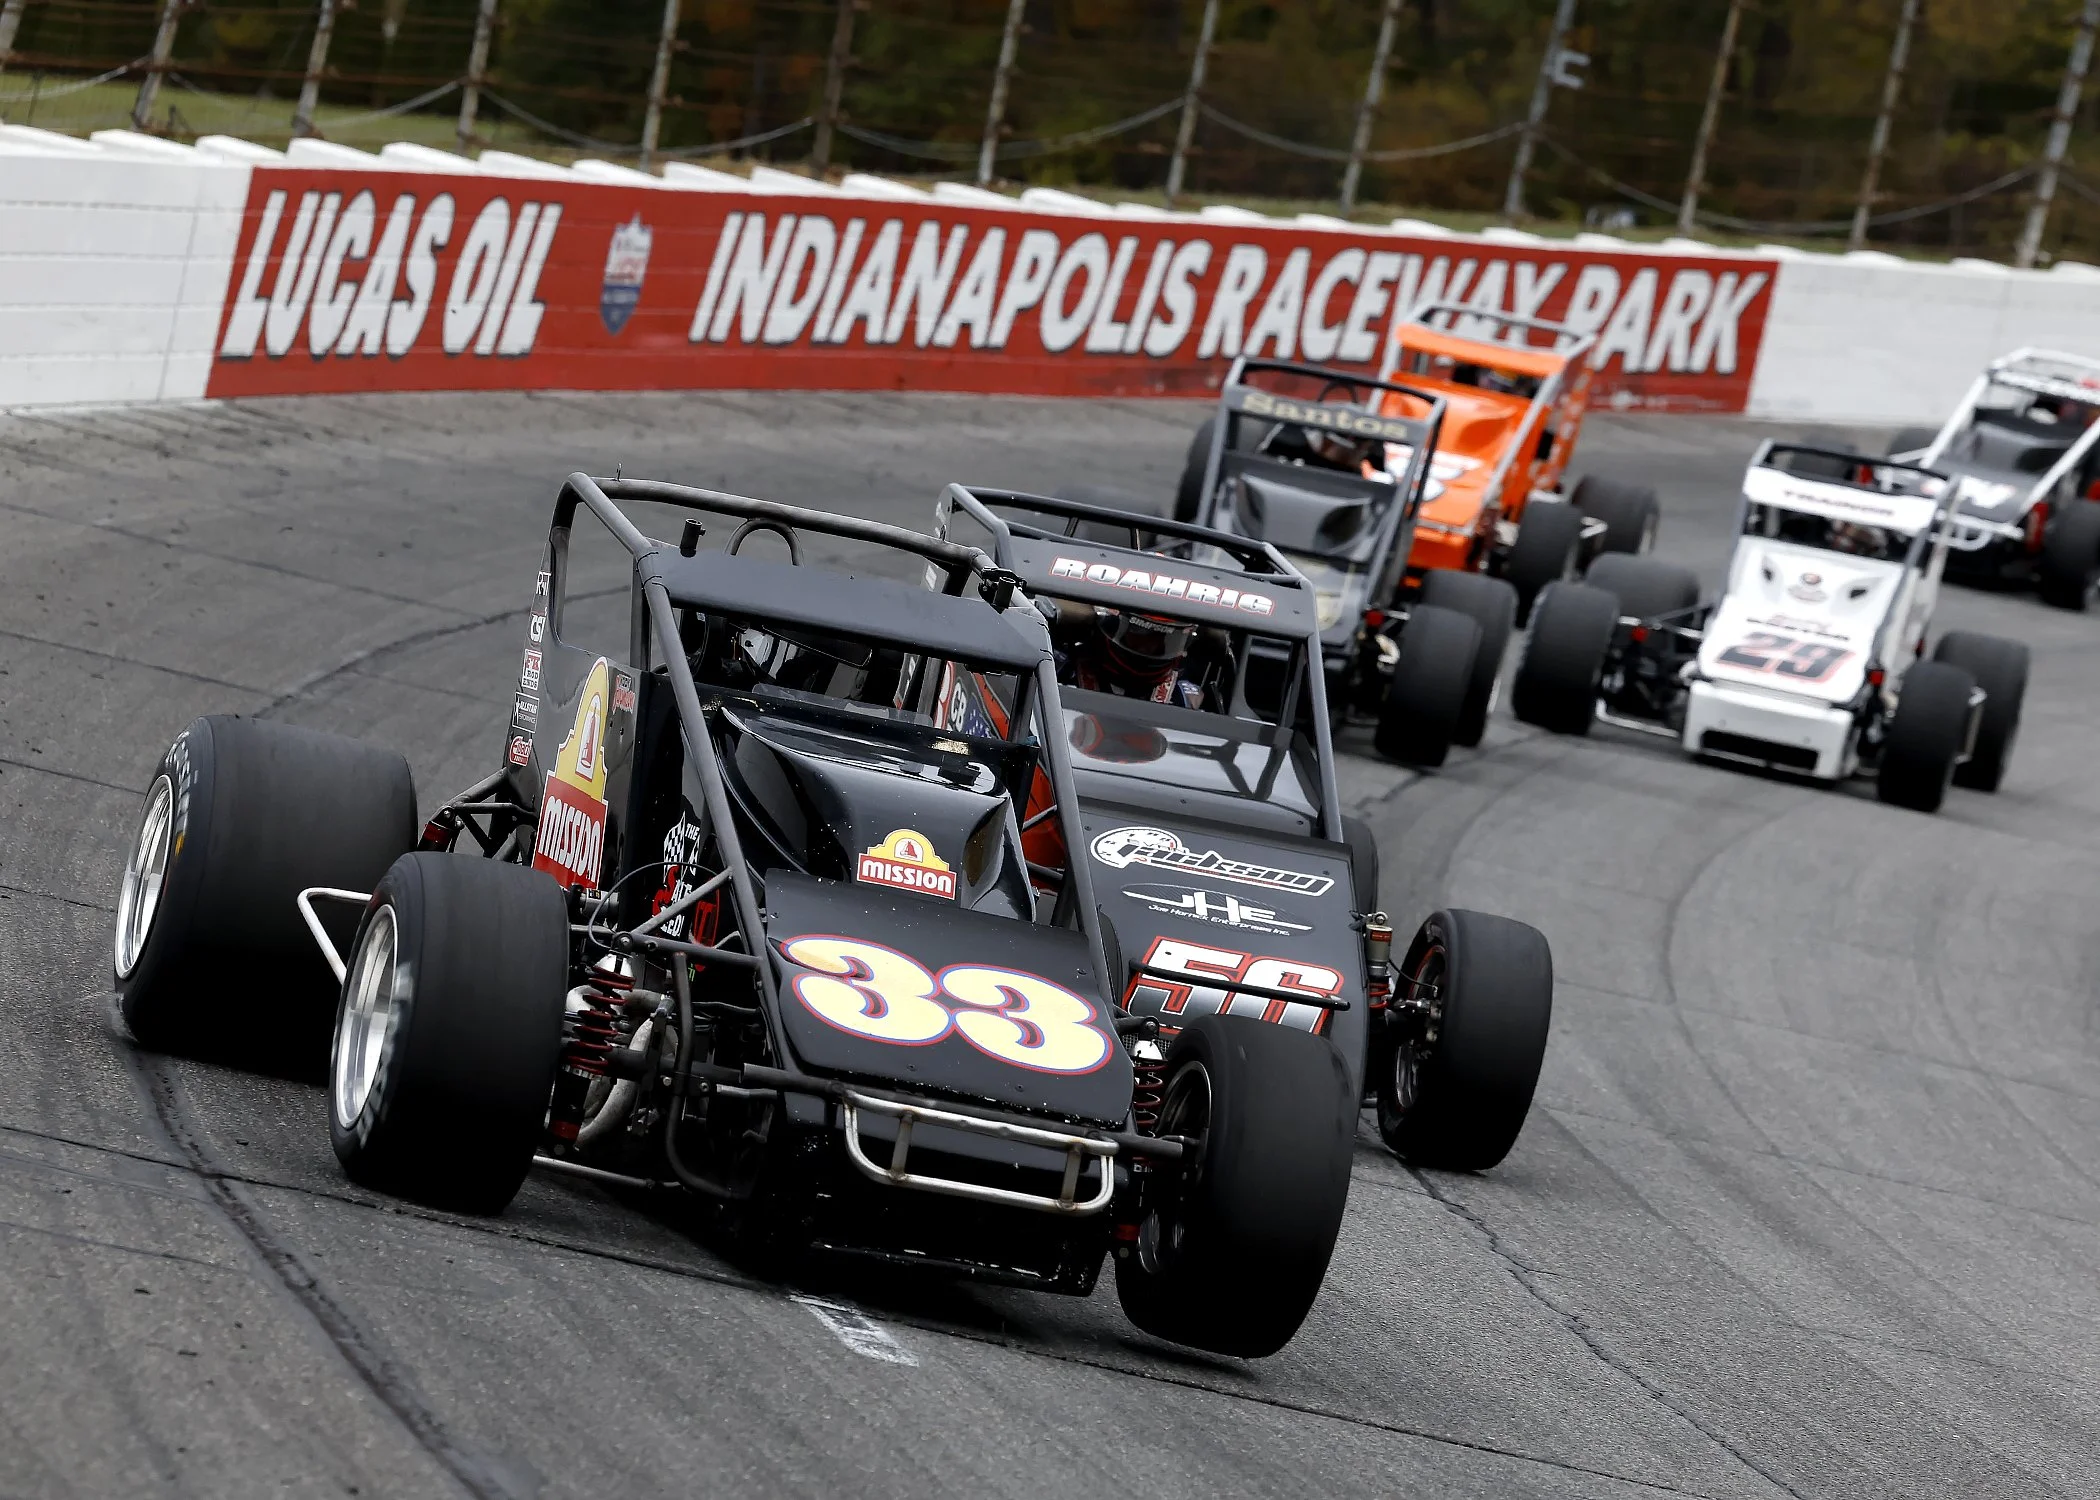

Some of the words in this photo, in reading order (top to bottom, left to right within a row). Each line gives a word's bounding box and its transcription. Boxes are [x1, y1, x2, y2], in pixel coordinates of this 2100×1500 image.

[219, 188, 456, 361] LUCAS
[442, 195, 563, 359] OIL
[689, 210, 1195, 359] INDIANAPOLIS
[1198, 241, 1568, 365] RACEWAY
[1562, 263, 1769, 376] PARK
[1243, 391, 1408, 440] Santos
[1049, 556, 1276, 617] ROAHRIG
[1128, 616, 1176, 635] SIMPSON
[537, 795, 601, 884] MISSION
[684, 822, 701, 841] THE
[861, 859, 953, 894] MISSION
[1148, 903, 1169, 914] Joe
[780, 933, 1114, 1076] 33
[1121, 935, 1346, 1036] 56
